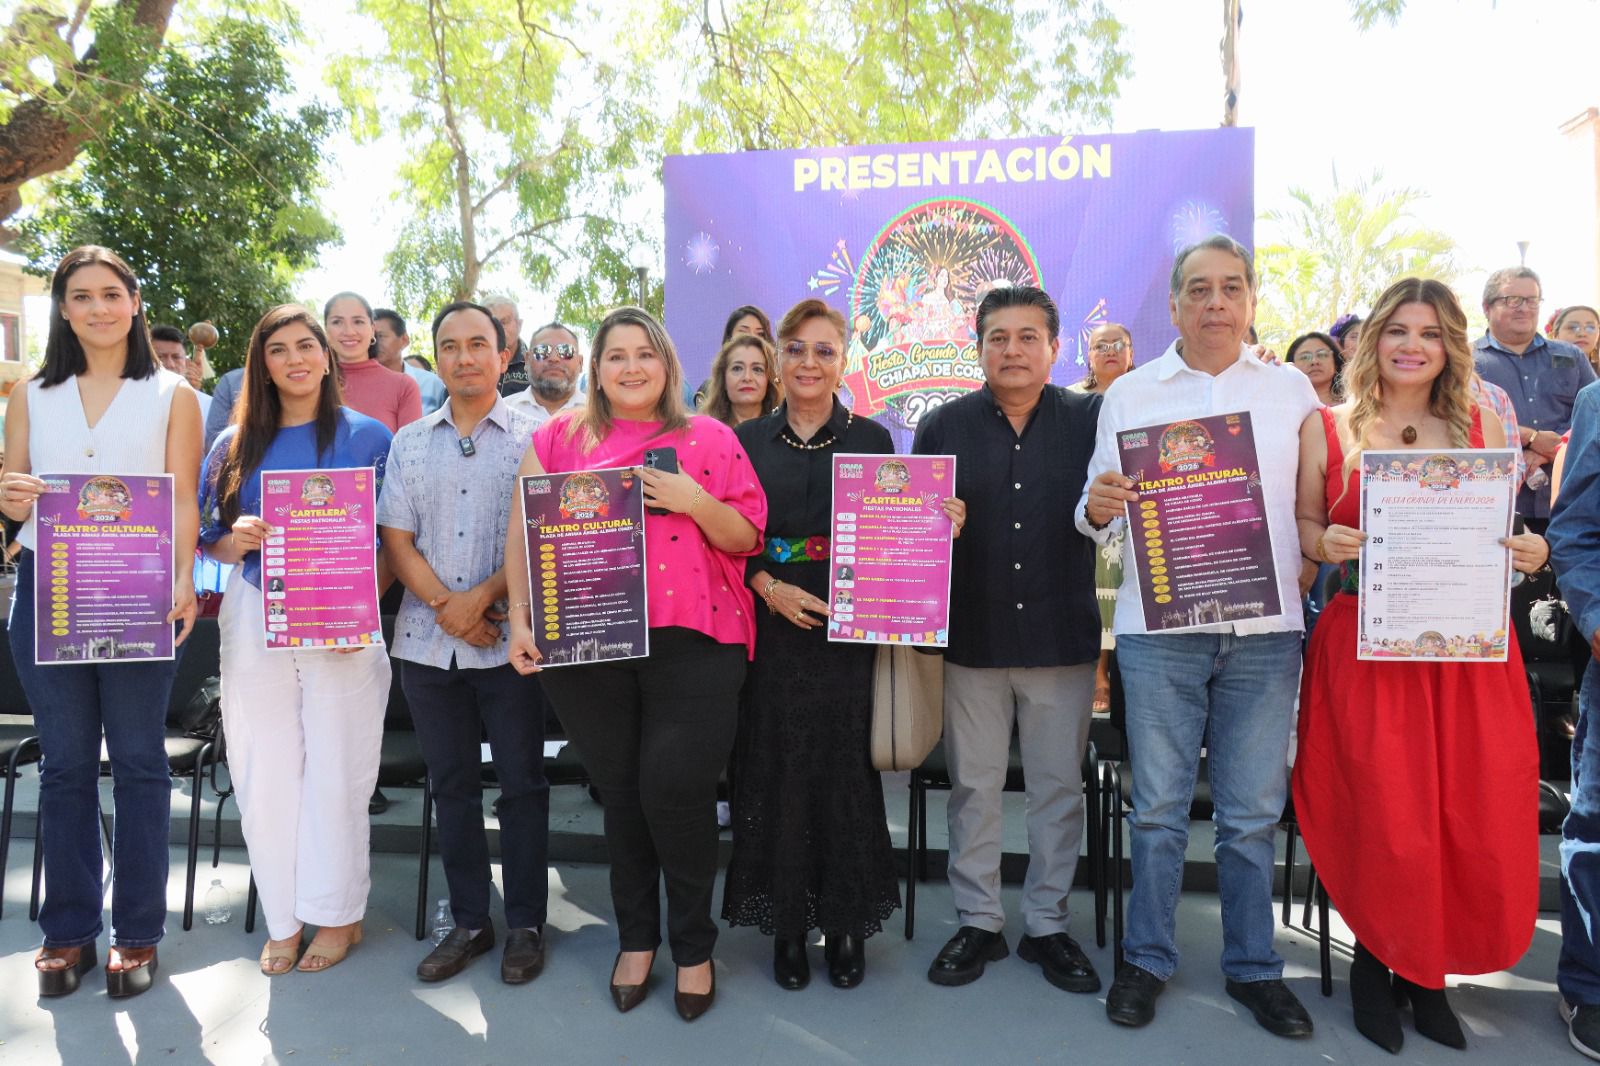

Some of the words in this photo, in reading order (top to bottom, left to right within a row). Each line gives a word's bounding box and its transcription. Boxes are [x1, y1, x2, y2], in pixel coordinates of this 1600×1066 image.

[793, 136, 1112, 191] PRESENTACIÓN
[870, 351, 905, 377] Fiesta
[911, 344, 957, 364] Grande
[962, 346, 979, 361] de
[880, 365, 931, 387] CHIAPA
[932, 363, 951, 376] DE
[953, 363, 987, 380] COR
[907, 394, 962, 425] 20
[1138, 477, 1184, 491] TEATRO
[1186, 467, 1247, 484] CULTURAL
[1228, 475, 1248, 483] CORZO
[862, 496, 923, 505] CARTELERA
[1381, 497, 1406, 505] FIESTA
[290, 508, 347, 518] CARTELERA
[1372, 507, 1382, 515] 19
[53, 525, 98, 533] TEATRO
[101, 525, 158, 533] CULTURAL
[539, 524, 580, 534] TEATRO
[582, 518, 633, 531] CULTURAL
[1372, 536, 1384, 544] 20
